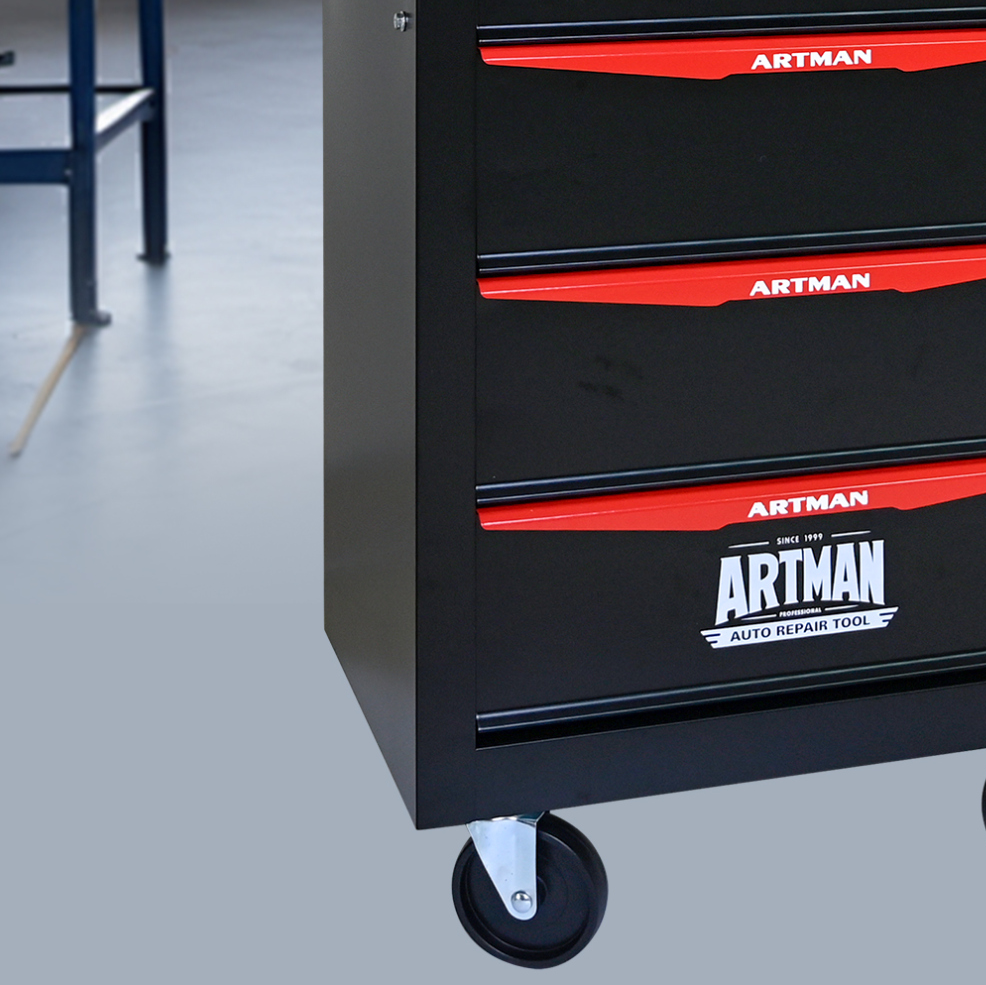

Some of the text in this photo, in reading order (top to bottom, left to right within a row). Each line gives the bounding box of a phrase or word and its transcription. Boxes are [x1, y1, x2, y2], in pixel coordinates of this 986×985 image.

[751, 49, 872, 70] ARTMAN
[749, 273, 870, 296] ARTMAN
[747, 490, 868, 518] ARTMAN
[776, 533, 824, 545] SINCE 1999
[715, 539, 886, 626] ARTMAN
[779, 607, 822, 617] PROFESSIONAL
[730, 615, 871, 642] AUTO REPAIR TOOL
